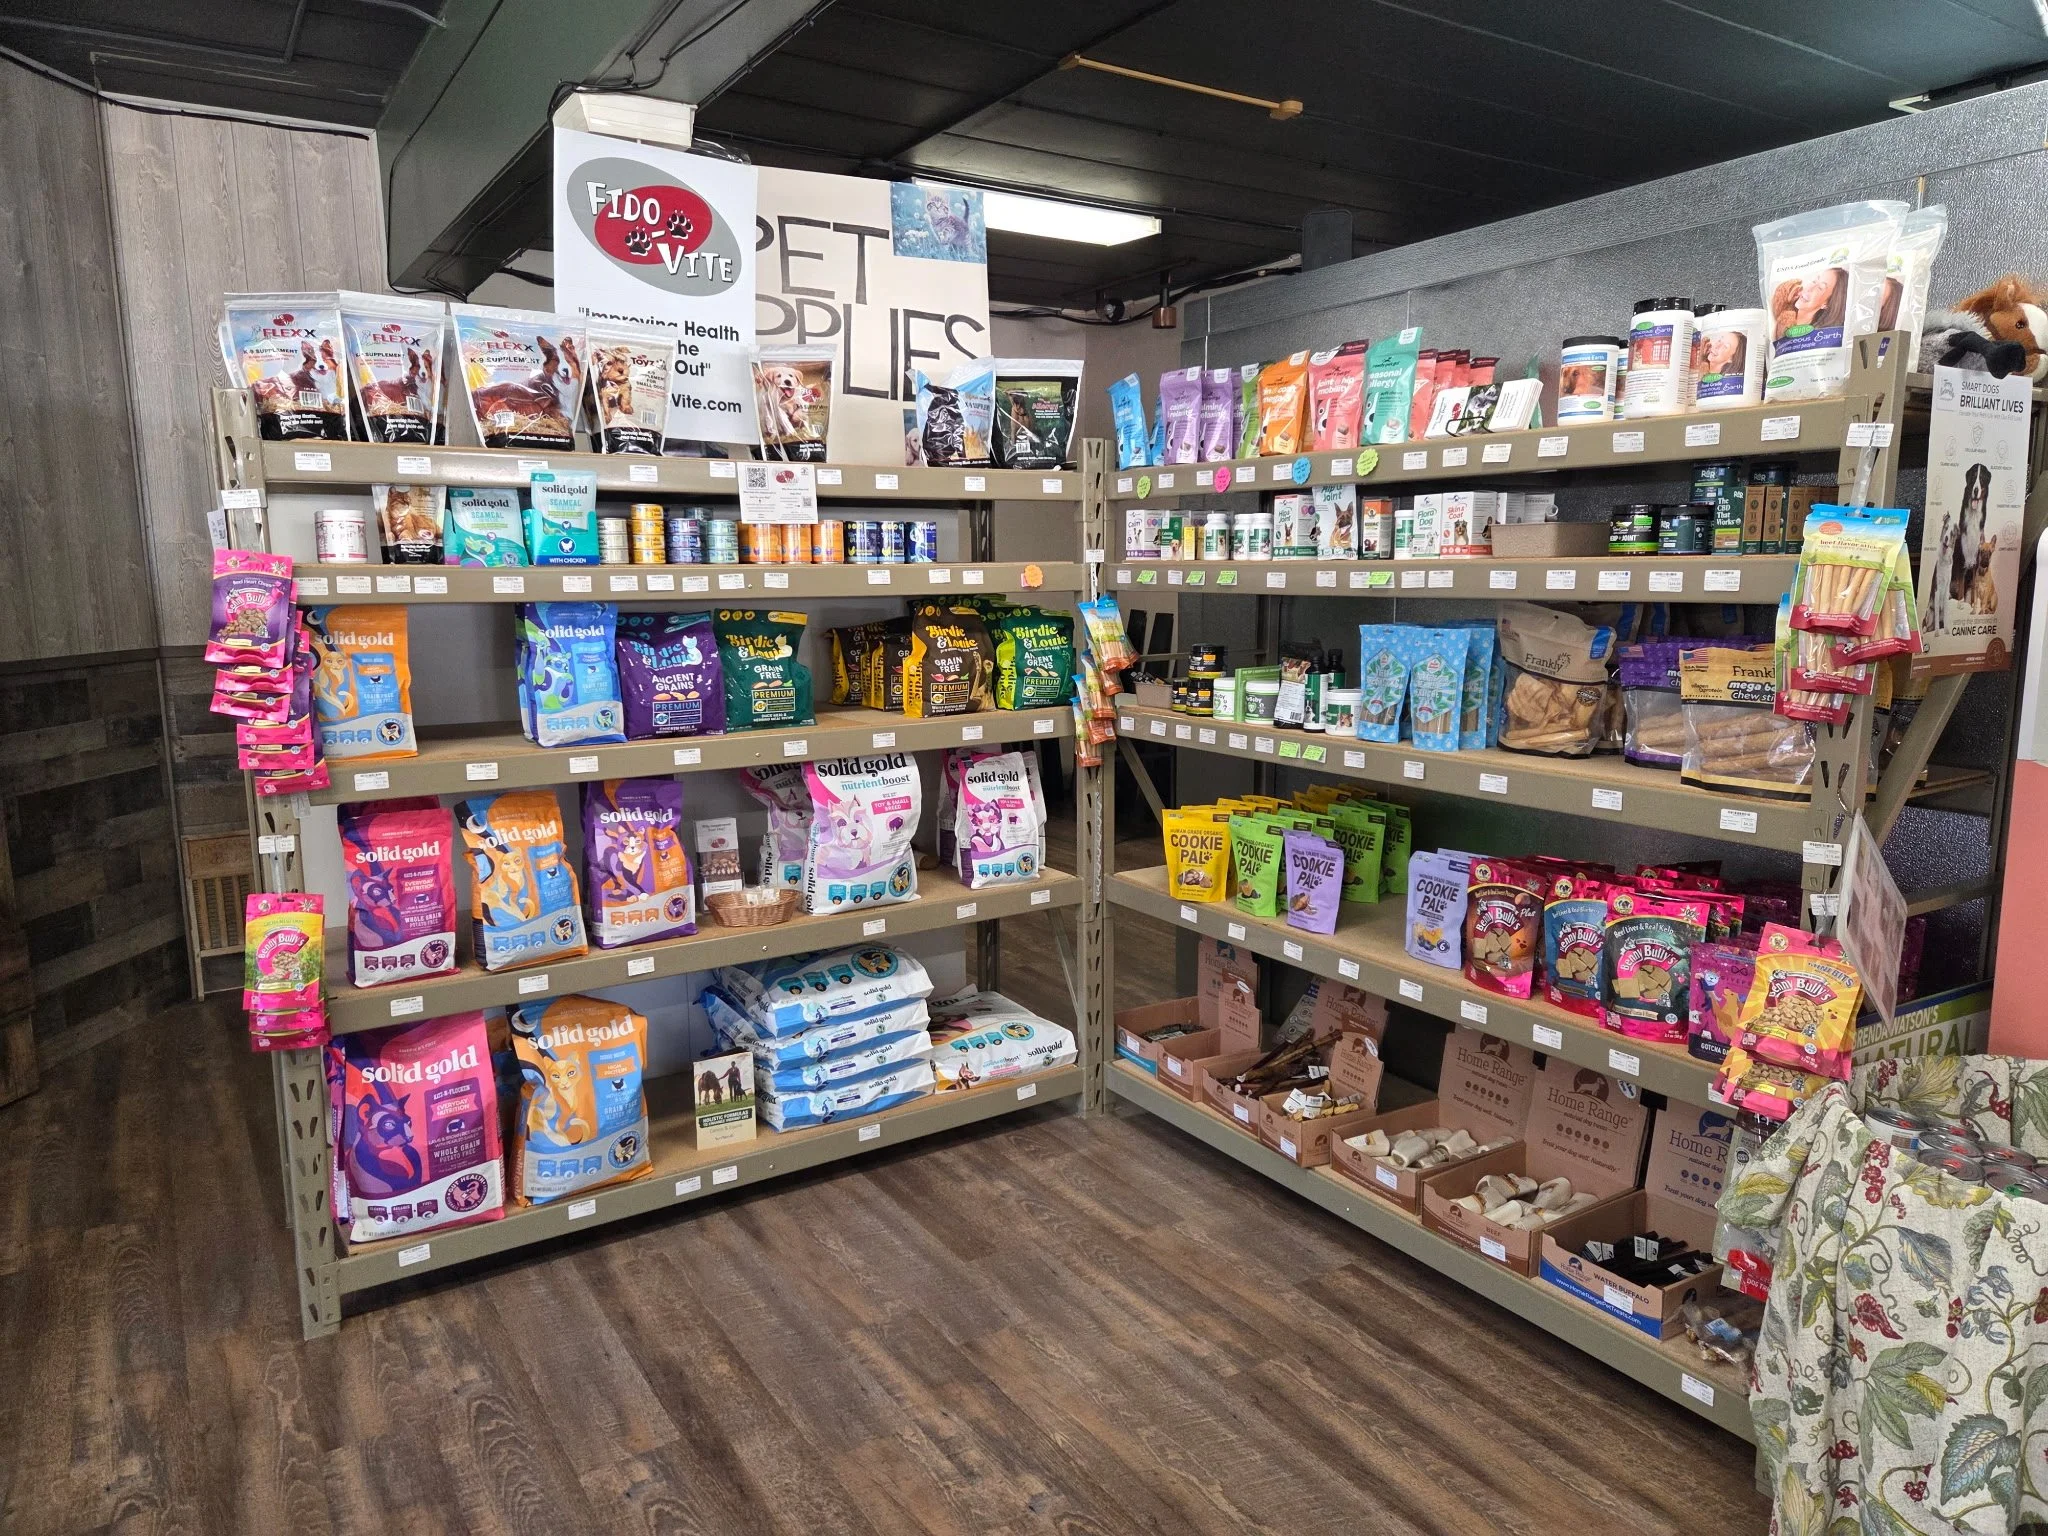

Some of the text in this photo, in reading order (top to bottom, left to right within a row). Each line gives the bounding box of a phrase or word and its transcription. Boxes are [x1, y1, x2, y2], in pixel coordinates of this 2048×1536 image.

[586, 181, 660, 225] FIDO
[684, 320, 740, 342] Health
[1654, 326, 1673, 336] Earth
[1813, 331, 1842, 342] Earth
[1317, 378, 1334, 388] joint
[1318, 383, 1349, 395] mobility
[1722, 383, 1743, 392] Earth
[1961, 381, 1982, 392] SMART
[1982, 384, 2000, 394] DOGS
[1959, 395, 2024, 413] BRILLIANT LIVES
[541, 484, 588, 497] solid gold
[1323, 492, 1343, 502] Joint
[461, 498, 510, 510] solid gold
[1718, 497, 1729, 505] The
[470, 510, 504, 520] SEAMEAL
[1417, 510, 1434, 519] Flora
[1447, 505, 1460, 514] Skin
[1448, 512, 1464, 520] Coat
[1717, 511, 1731, 519] That
[1127, 520, 1141, 529] Calm
[1419, 518, 1433, 527] Dog
[1716, 518, 1735, 526] Works
[1622, 534, 1637, 542] JOINT
[538, 624, 605, 640] solid gold
[925, 625, 966, 638] Birdie
[1012, 623, 1059, 640] Birdie
[1951, 625, 1998, 637] CANINE CARE
[315, 630, 395, 649] solid gold
[725, 633, 775, 648] Birdie
[936, 636, 978, 649] & Louie
[1023, 634, 1069, 649] & Louie
[934, 656, 963, 666] GRAIN
[1524, 653, 1565, 674] Frankly
[753, 664, 784, 673] GRAIN
[759, 671, 783, 680] FREE
[939, 664, 961, 673] FREE
[651, 672, 695, 684] ANCIENT
[655, 681, 695, 692] GRAINS
[932, 683, 968, 692] PREMIUM
[1728, 682, 1762, 692] mega
[754, 690, 795, 699] PREMIUM
[1731, 690, 1755, 701] chew
[655, 701, 700, 712] PREMIUM
[817, 752, 908, 778] solid gold
[841, 774, 911, 792] nutrientboost
[967, 770, 1019, 785] solid gold
[873, 799, 910, 810] TOY SMALL
[884, 803, 902, 811] BREED
[600, 807, 675, 825] solid gold
[476, 820, 559, 852] solid gold
[1170, 833, 1223, 851] COOKIE
[355, 840, 441, 864] solid gold
[1180, 849, 1207, 865] PAL
[1236, 840, 1274, 865] COOKIE
[1239, 858, 1257, 876] PAL
[1292, 853, 1336, 878] COOKIE
[403, 883, 435, 892] NUTRITION
[1296, 871, 1316, 890] PAL
[1416, 879, 1460, 903] COOKIE
[1420, 895, 1442, 914] PAL
[404, 913, 442, 924] WHOLE GRAIN
[1475, 907, 1521, 933] Benny Bully's
[1613, 928, 1626, 939] Beef
[1625, 925, 1640, 934] Liver
[1644, 922, 1658, 930] Real
[1659, 924, 1675, 935] Kelp
[1577, 928, 1604, 948] Bully's
[257, 933, 305, 959] Benny Bully's
[1620, 944, 1677, 972] Benny Bully's
[863, 984, 892, 996] solid gold
[1795, 978, 1832, 1001] Bully's
[864, 1013, 892, 1027] solid gold
[526, 1014, 636, 1051] solid gold
[864, 1044, 893, 1059] solid gold
[1027, 1040, 1063, 1057] solid gold
[1700, 1043, 1722, 1055] GOTCHA
[360, 1044, 480, 1085] solid gold
[1456, 1046, 1525, 1087] Home Range
[868, 1075, 897, 1089] solid gold
[436, 1098, 470, 1112] EVERYDAY
[436, 1103, 471, 1116] NUTRITION
[1473, 1102, 1483, 1112] dog
[1547, 1087, 1629, 1130] Home Range
[702, 1109, 749, 1123] HOLISTIC FORMULAS
[1563, 1111, 1583, 1123] natural
[1582, 1116, 1593, 1127] dog
[433, 1140, 482, 1159] WHOLE GRAIN
[1554, 1143, 1578, 1158] your dog
[1669, 1129, 1712, 1159] Home
[439, 1153, 460, 1163] POTATO
[1709, 1163, 1724, 1175] dog
[1680, 1190, 1708, 1208] your dog
[1593, 1272, 1650, 1305] WATER BUFFALO
